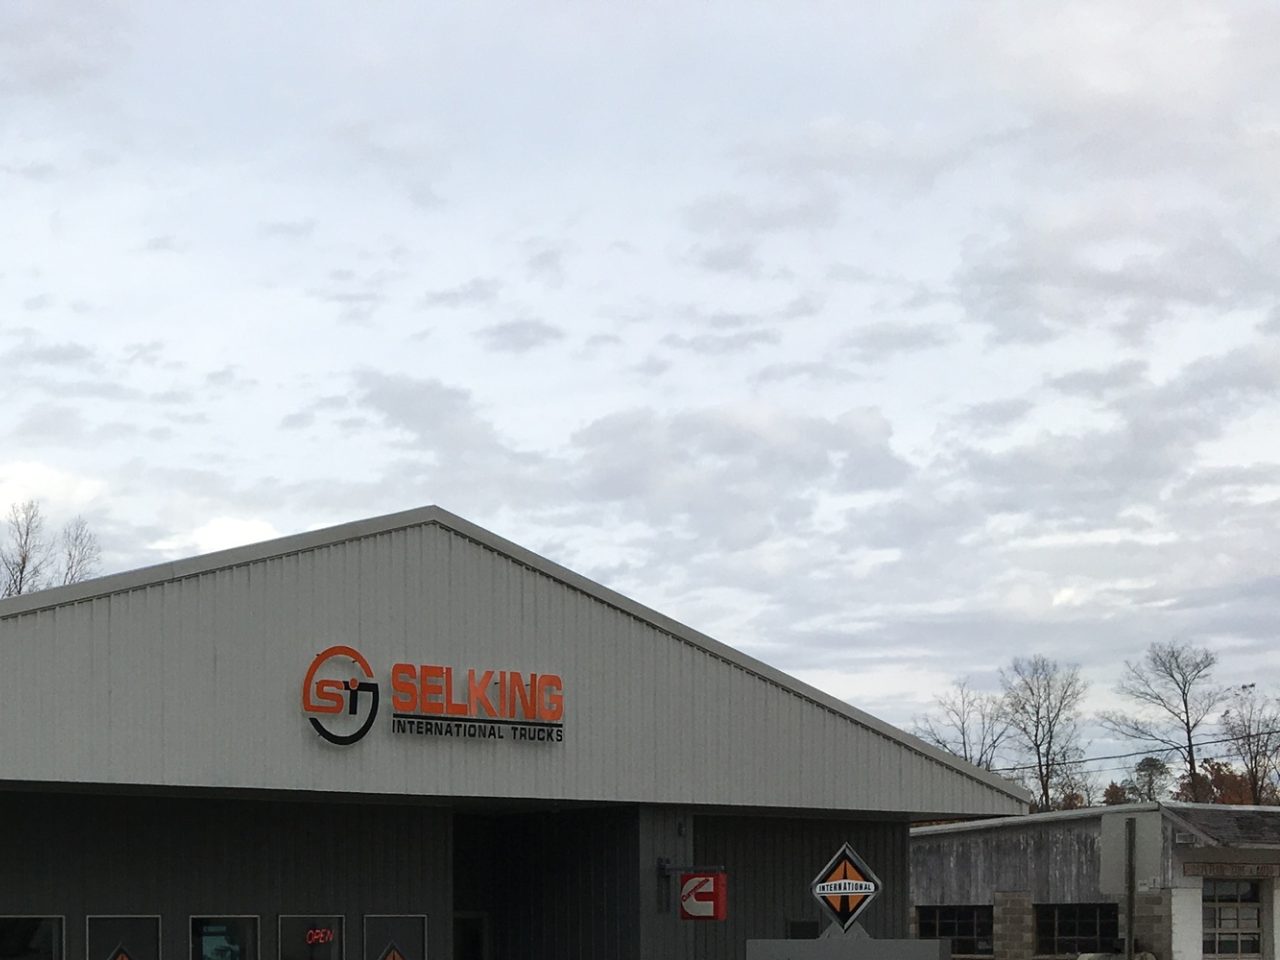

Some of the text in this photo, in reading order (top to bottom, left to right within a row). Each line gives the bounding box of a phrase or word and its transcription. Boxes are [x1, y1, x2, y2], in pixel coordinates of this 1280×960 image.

[391, 663, 564, 721] SELKING
[392, 719, 563, 742] INTERNATIONAL TRUCKS
[818, 881, 872, 892] INTERNATIONAL
[306, 929, 333, 944] OPEN
